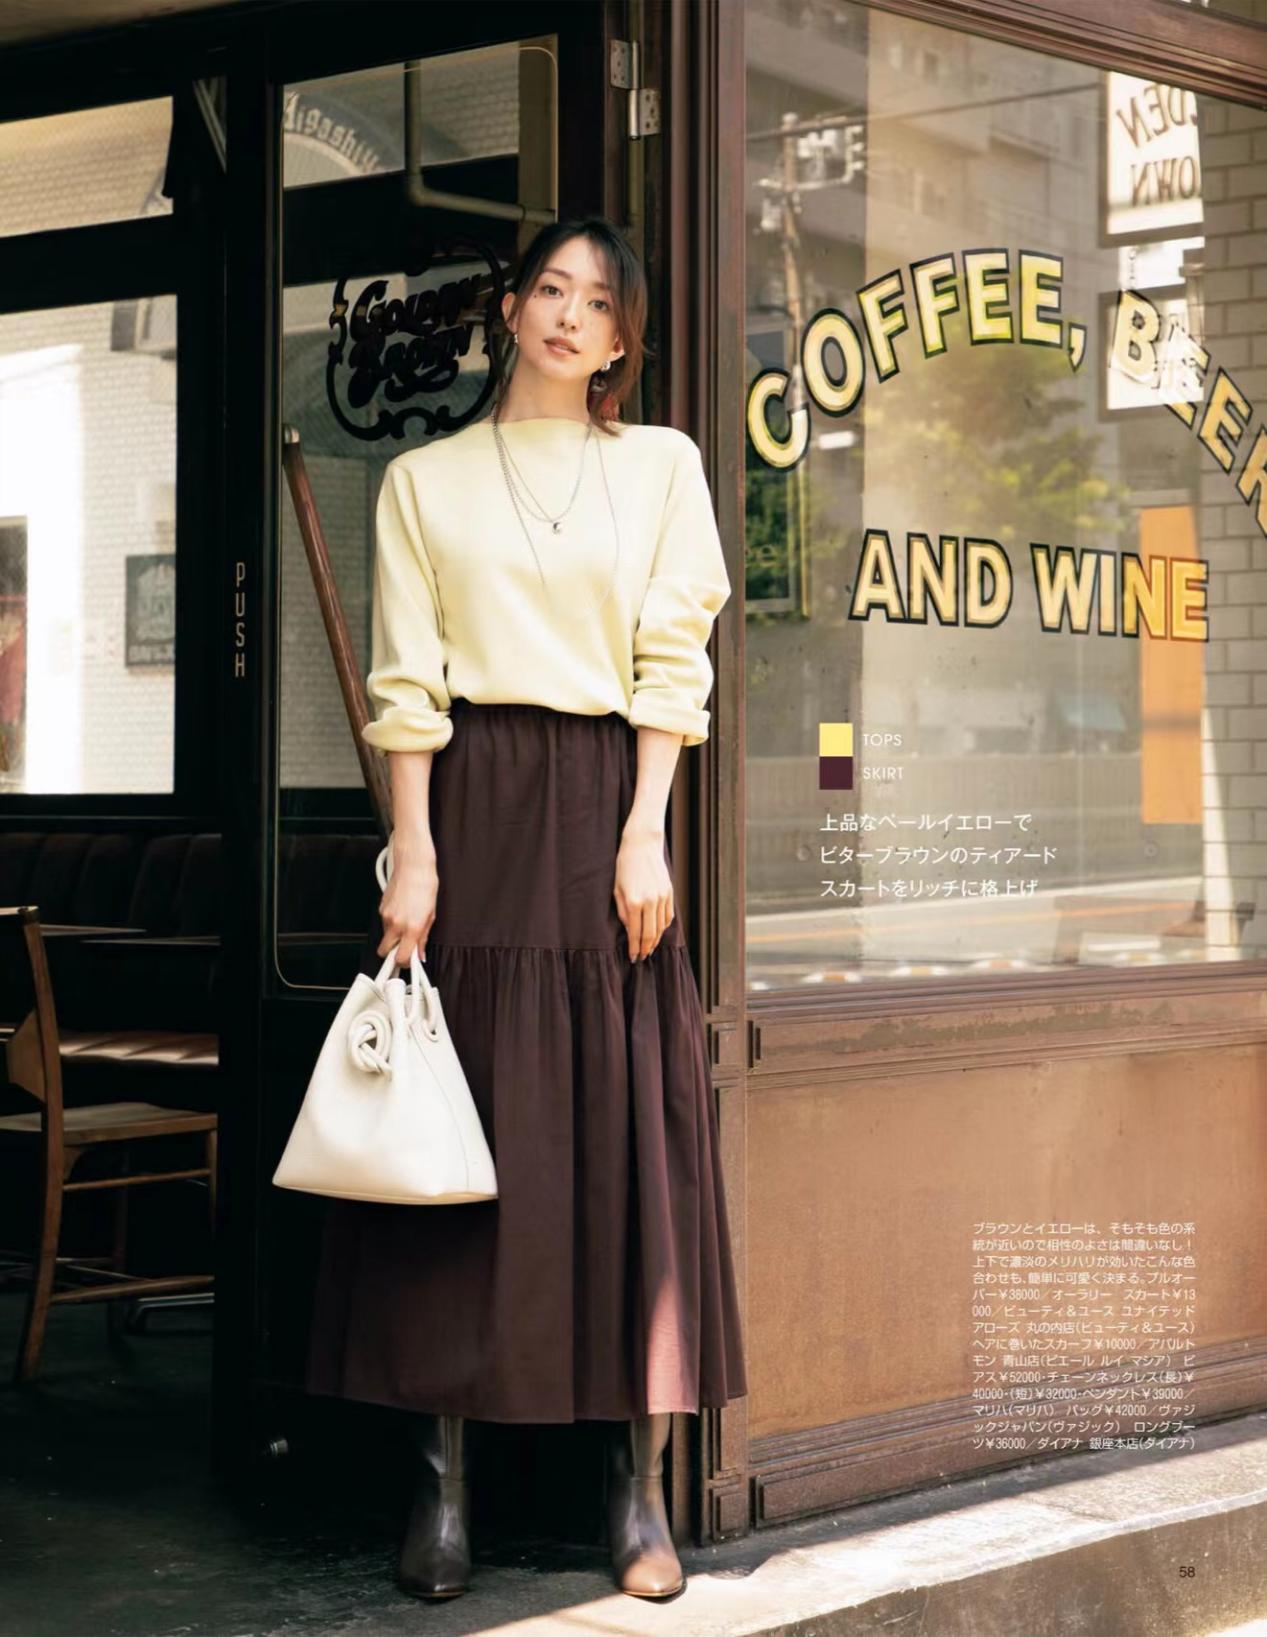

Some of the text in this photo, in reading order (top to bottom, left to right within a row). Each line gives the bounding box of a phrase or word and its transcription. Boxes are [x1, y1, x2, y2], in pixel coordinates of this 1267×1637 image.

[746, 247, 1087, 471] COFFEE,
[234, 562, 246, 678] PUSH
[848, 529, 1210, 642] AND WINE
